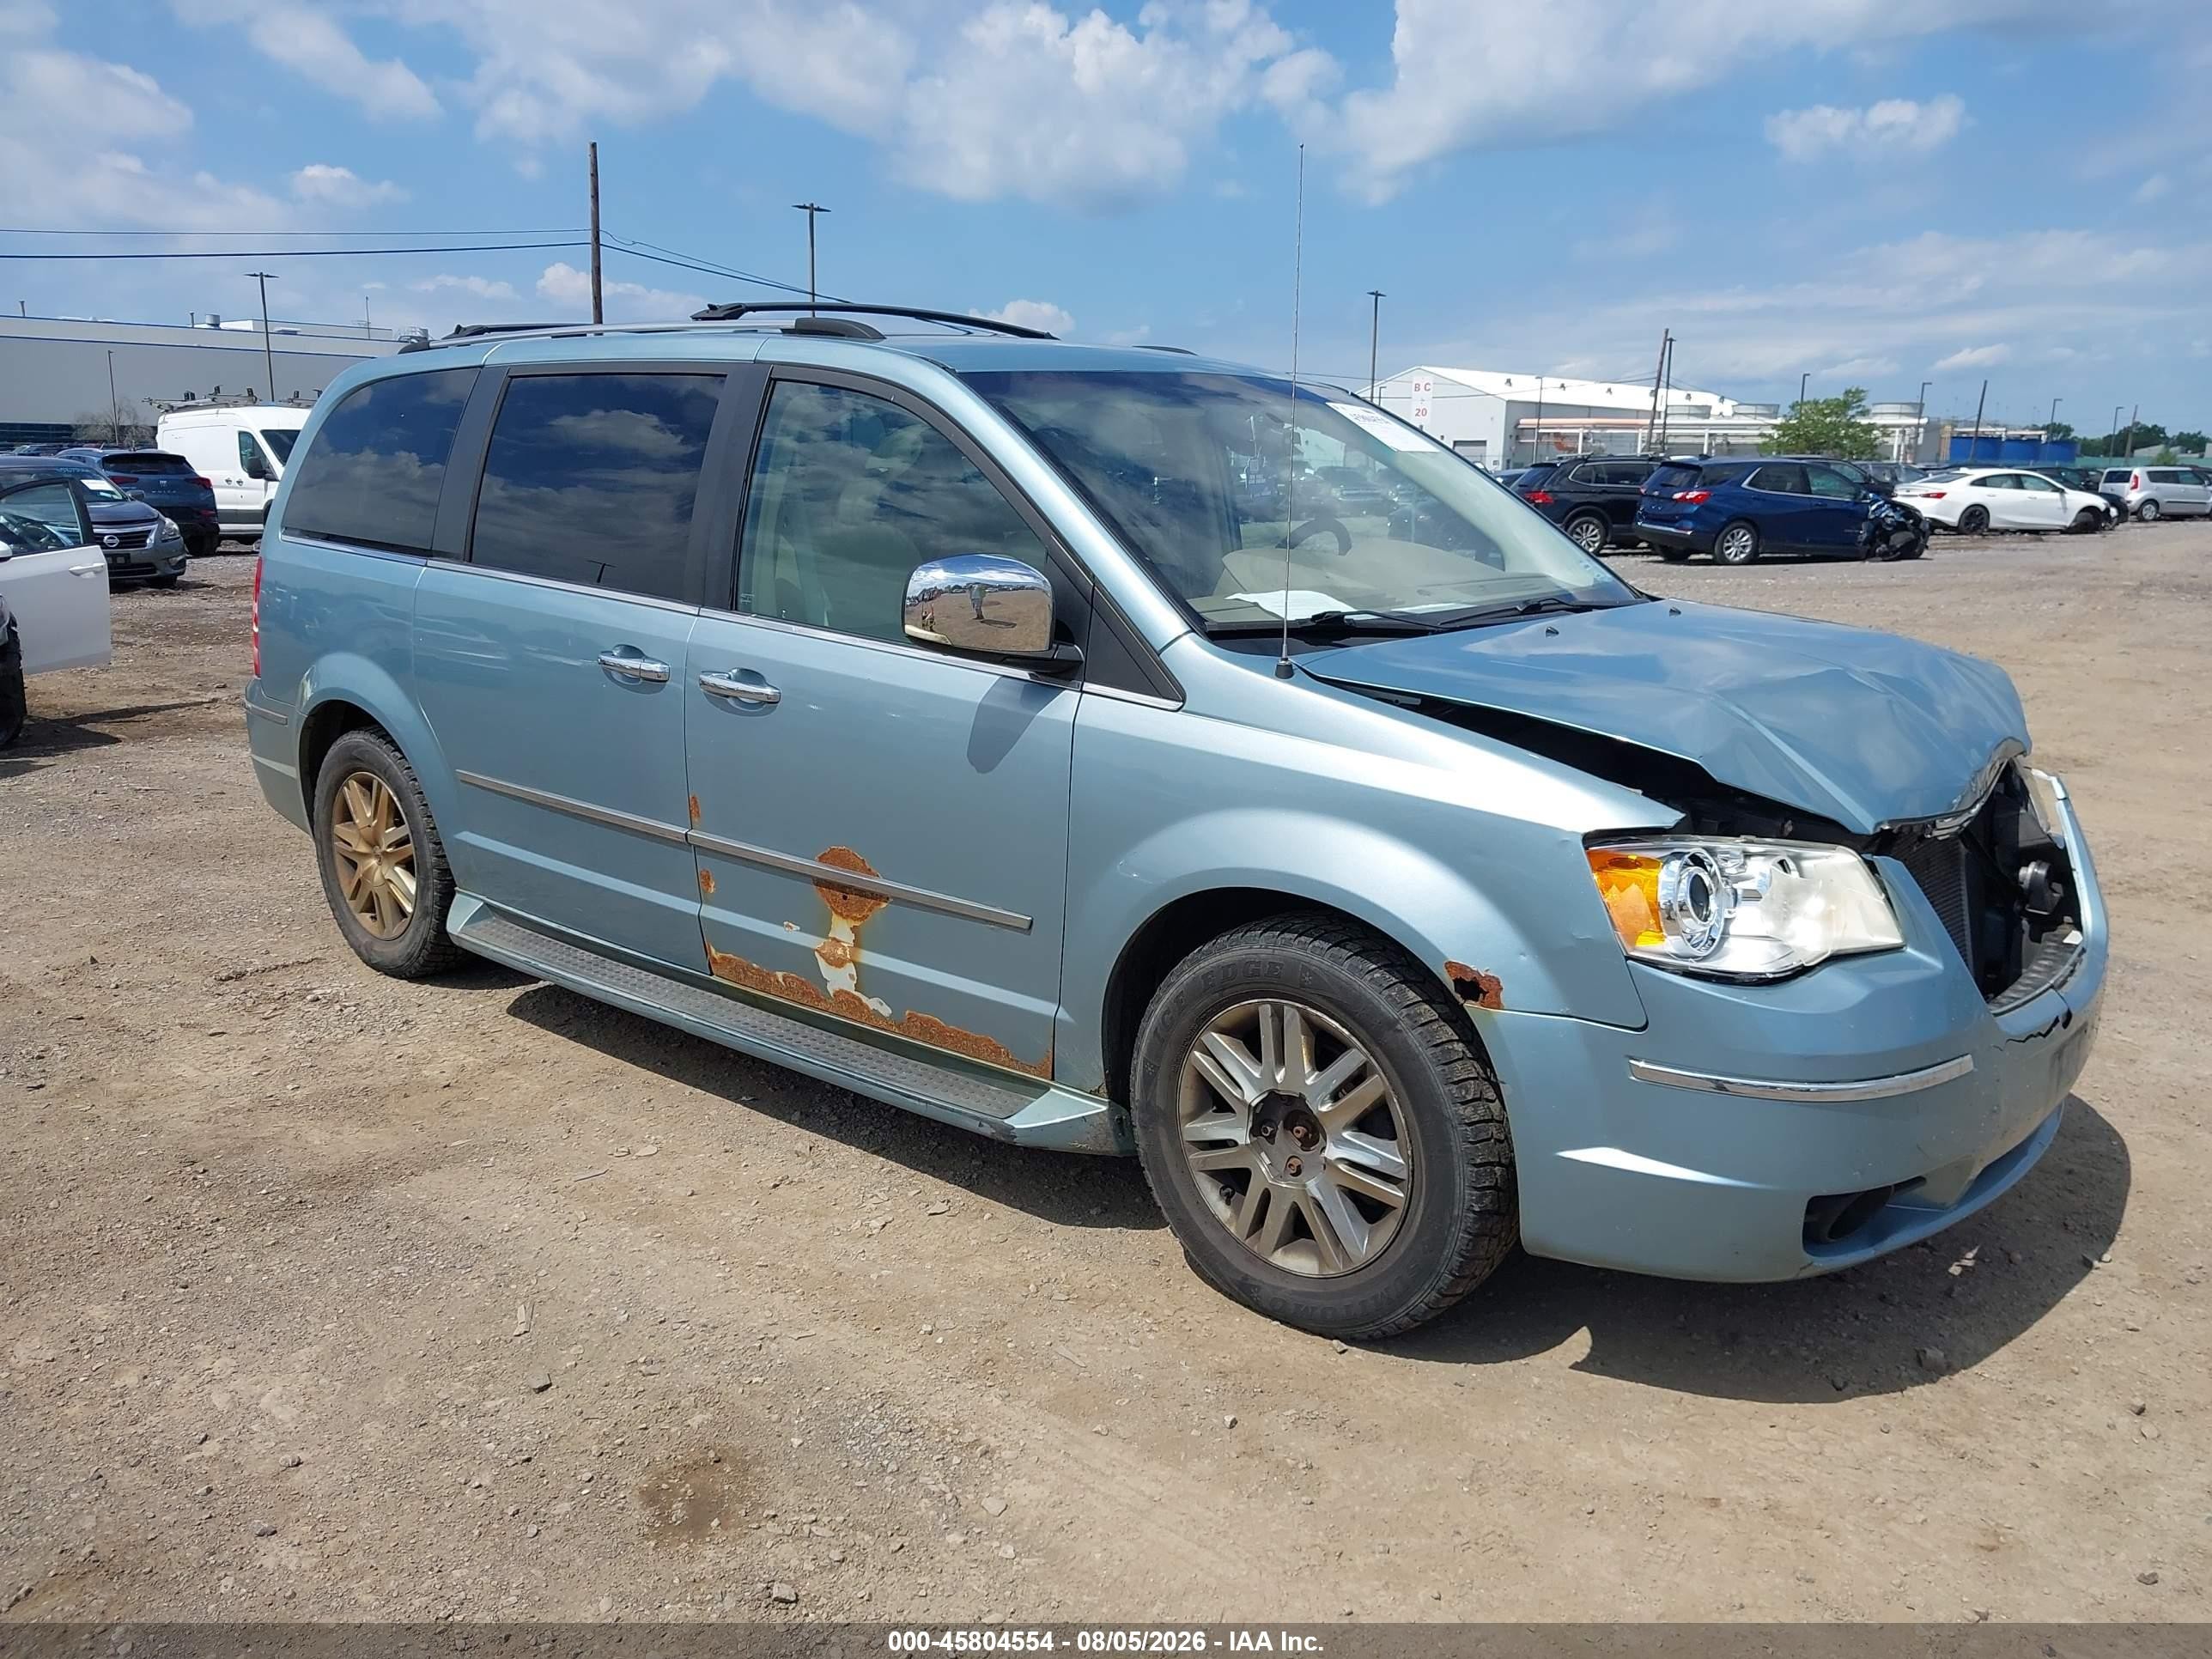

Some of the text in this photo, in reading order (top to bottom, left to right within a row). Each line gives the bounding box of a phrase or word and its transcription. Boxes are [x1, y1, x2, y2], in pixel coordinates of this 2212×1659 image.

[1414, 382, 1431, 392] B C
[1414, 408, 1428, 417] 20
[1202, 960, 1285, 989] EDGE
